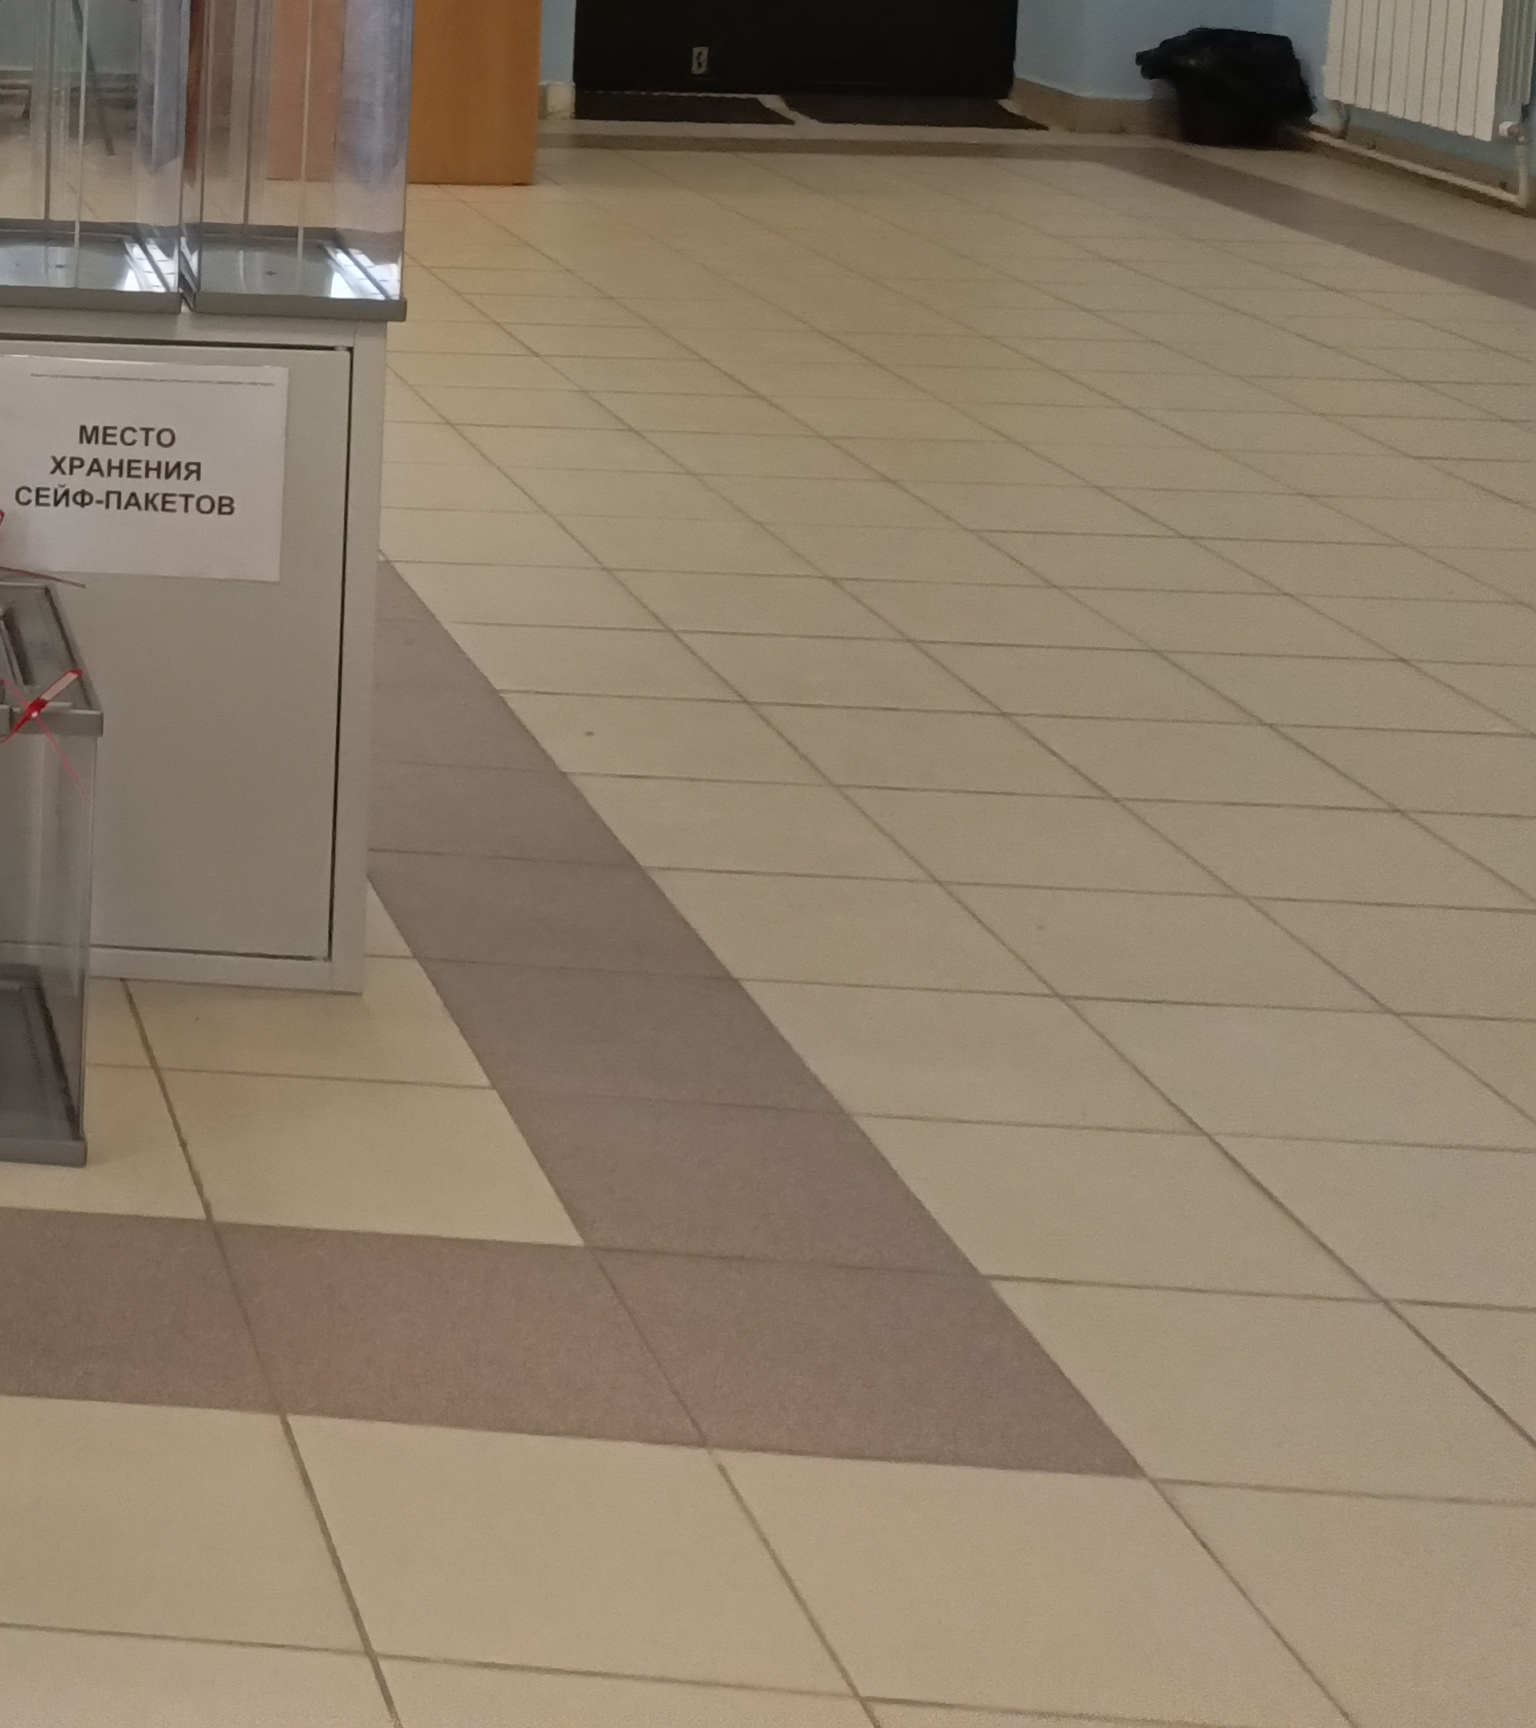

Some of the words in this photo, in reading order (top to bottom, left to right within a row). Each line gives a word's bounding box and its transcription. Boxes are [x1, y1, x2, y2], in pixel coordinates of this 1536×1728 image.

[78, 424, 177, 449] МЕСТО
[49, 454, 202, 482] ХРАНЕНИЯ
[14, 483, 236, 516] СЕЙФ-ПАКЕТОВ
